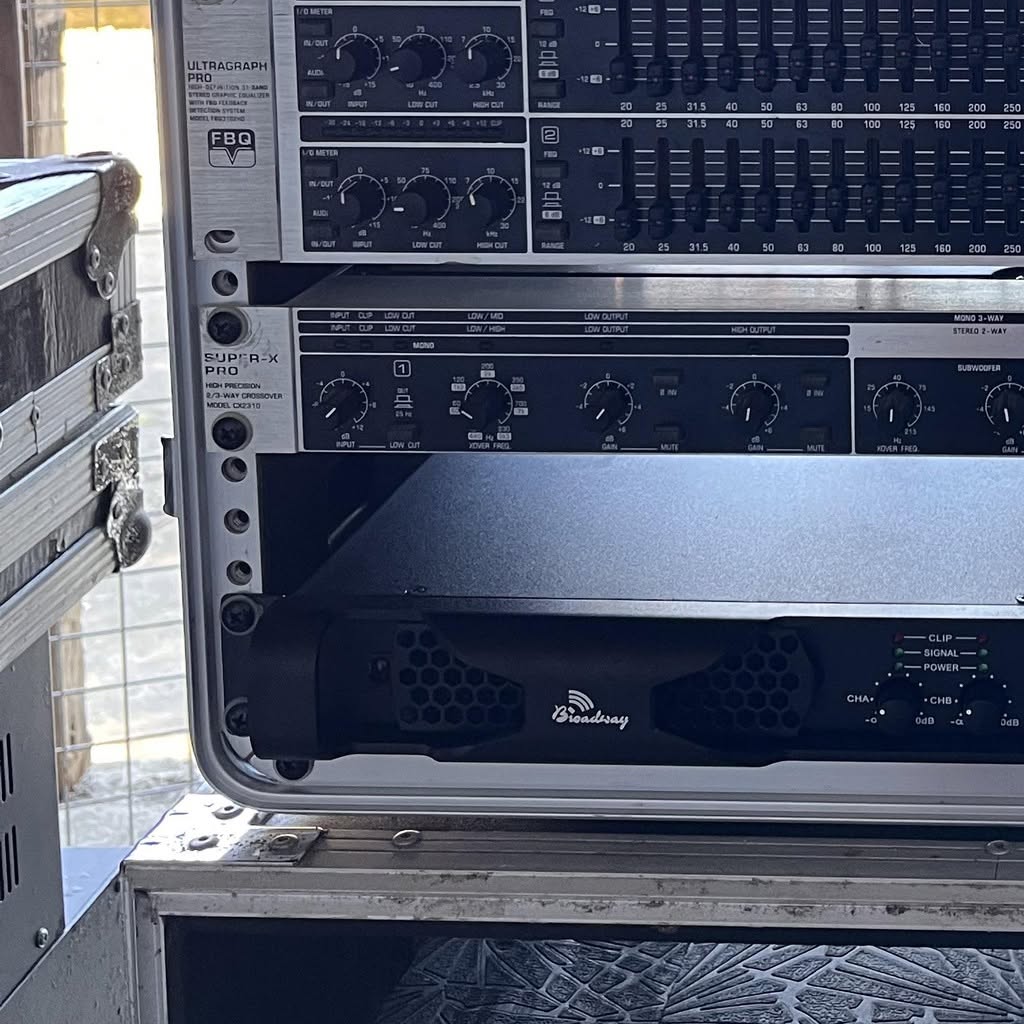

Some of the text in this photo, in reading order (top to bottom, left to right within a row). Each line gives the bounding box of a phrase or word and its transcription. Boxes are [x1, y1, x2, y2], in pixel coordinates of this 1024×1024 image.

[187, 60, 269, 72] ULTRAGRAPH
[187, 72, 213, 83] PRO
[211, 131, 253, 146] FBQ
[953, 313, 1005, 323] MONO 3-WAY
[952, 327, 1008, 336] STEREO 2-WAY
[204, 366, 240, 376] PRO
[957, 363, 1001, 372] SUBWOOFER
[205, 382, 261, 390] HIGH PRECISION
[240, 392, 283, 400] CROSSOVER
[206, 402, 231, 410] MODEL
[928, 633, 953, 643] CLIP
[923, 648, 959, 658] SIGNAL
[923, 663, 959, 672] POWER
[846, 694, 870, 703] CHA
[929, 696, 953, 705] CHB
[915, 716, 935, 725] 0dB
